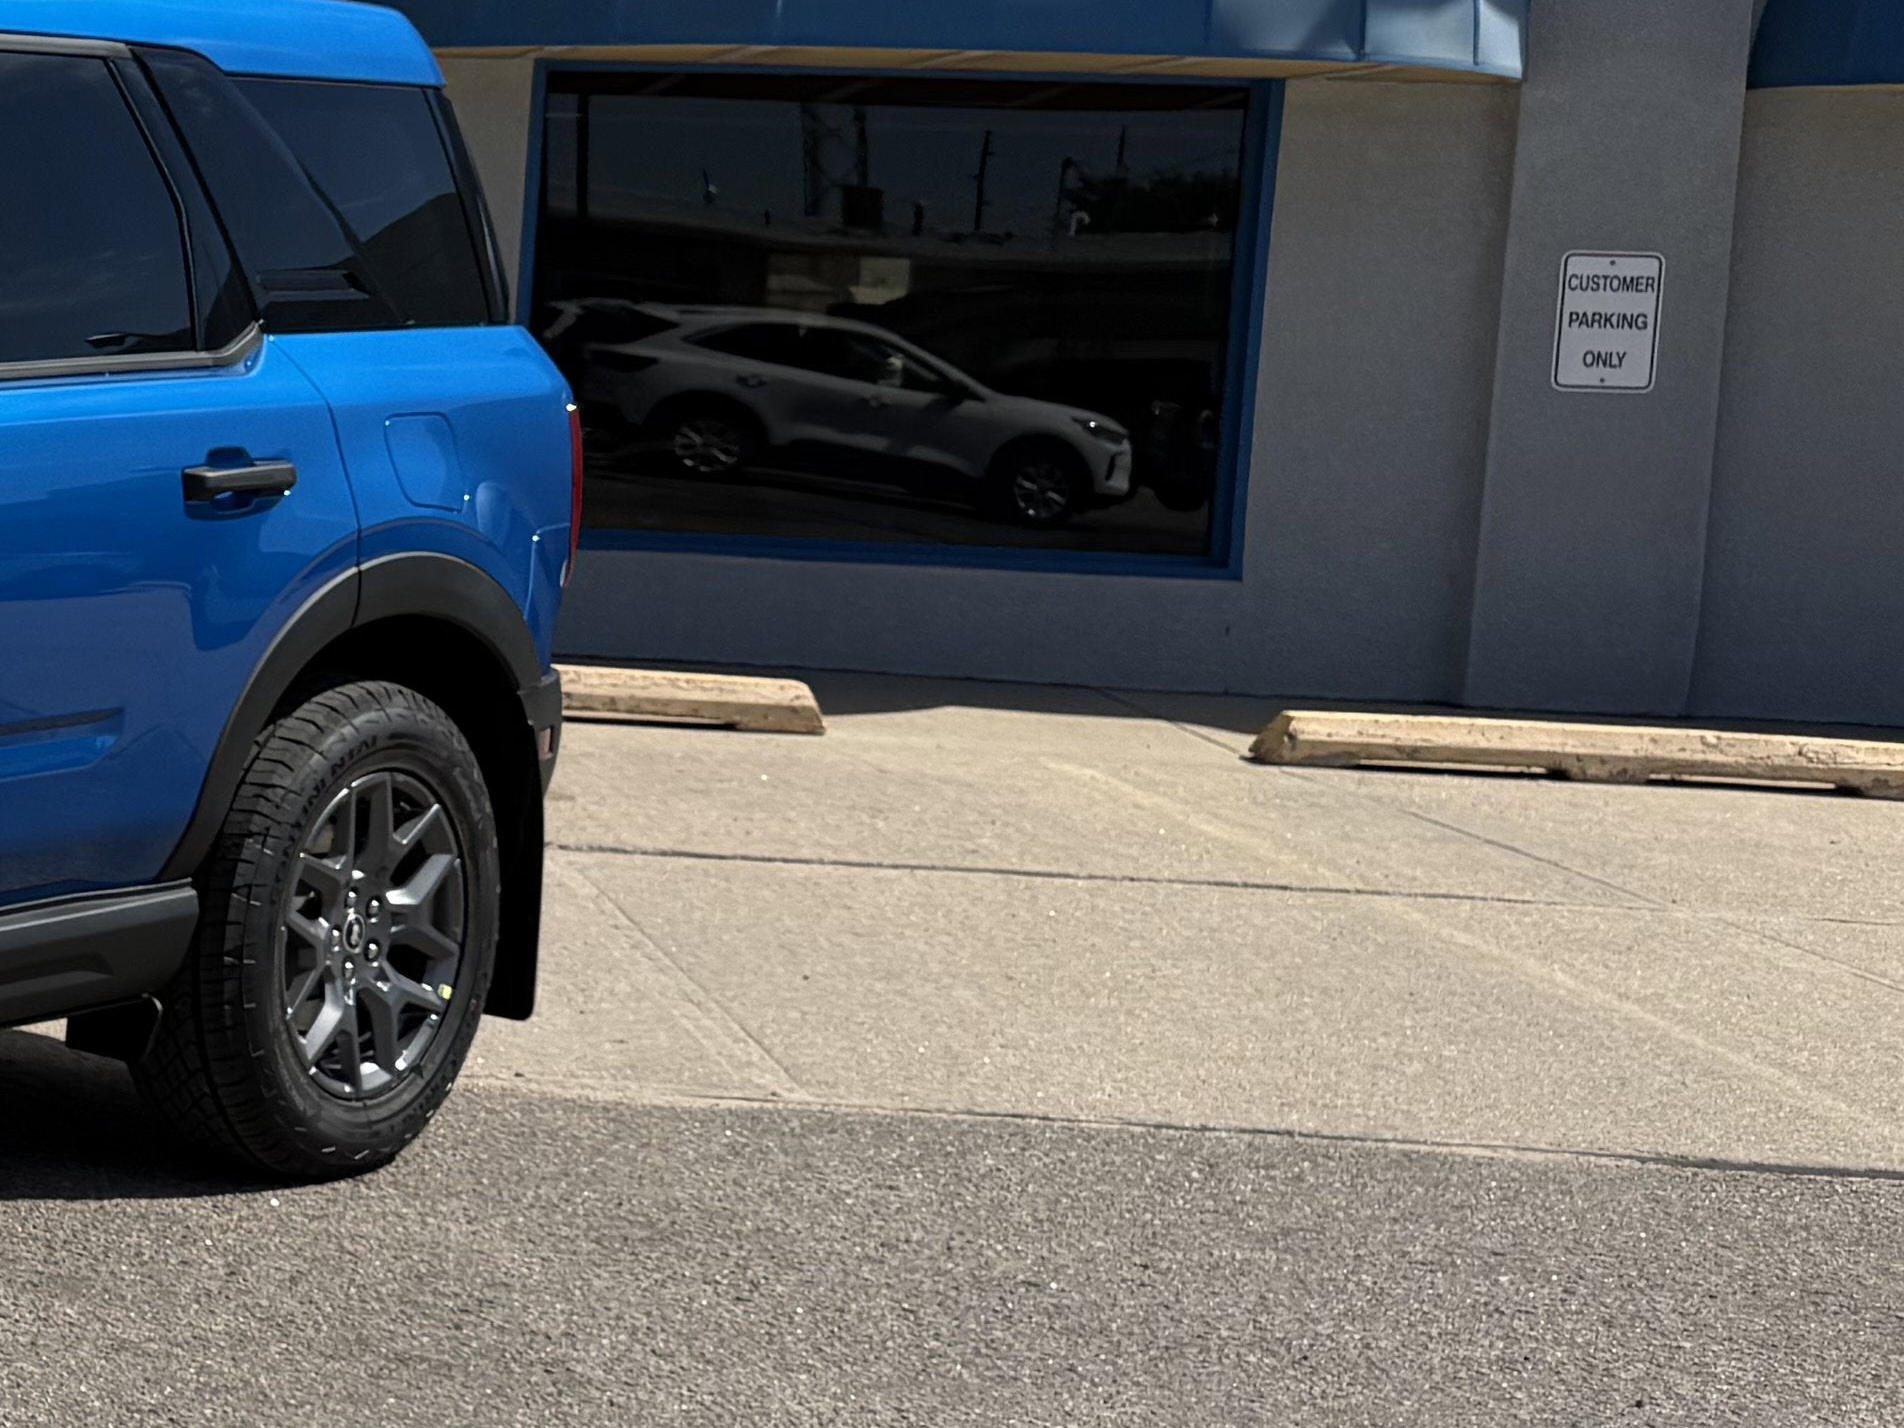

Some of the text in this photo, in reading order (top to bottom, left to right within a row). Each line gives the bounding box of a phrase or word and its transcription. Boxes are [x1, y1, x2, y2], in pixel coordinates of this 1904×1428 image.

[1568, 274, 1656, 293] CUSTOMER
[1568, 311, 1648, 330] PARKING
[1582, 350, 1627, 369] ONLY
